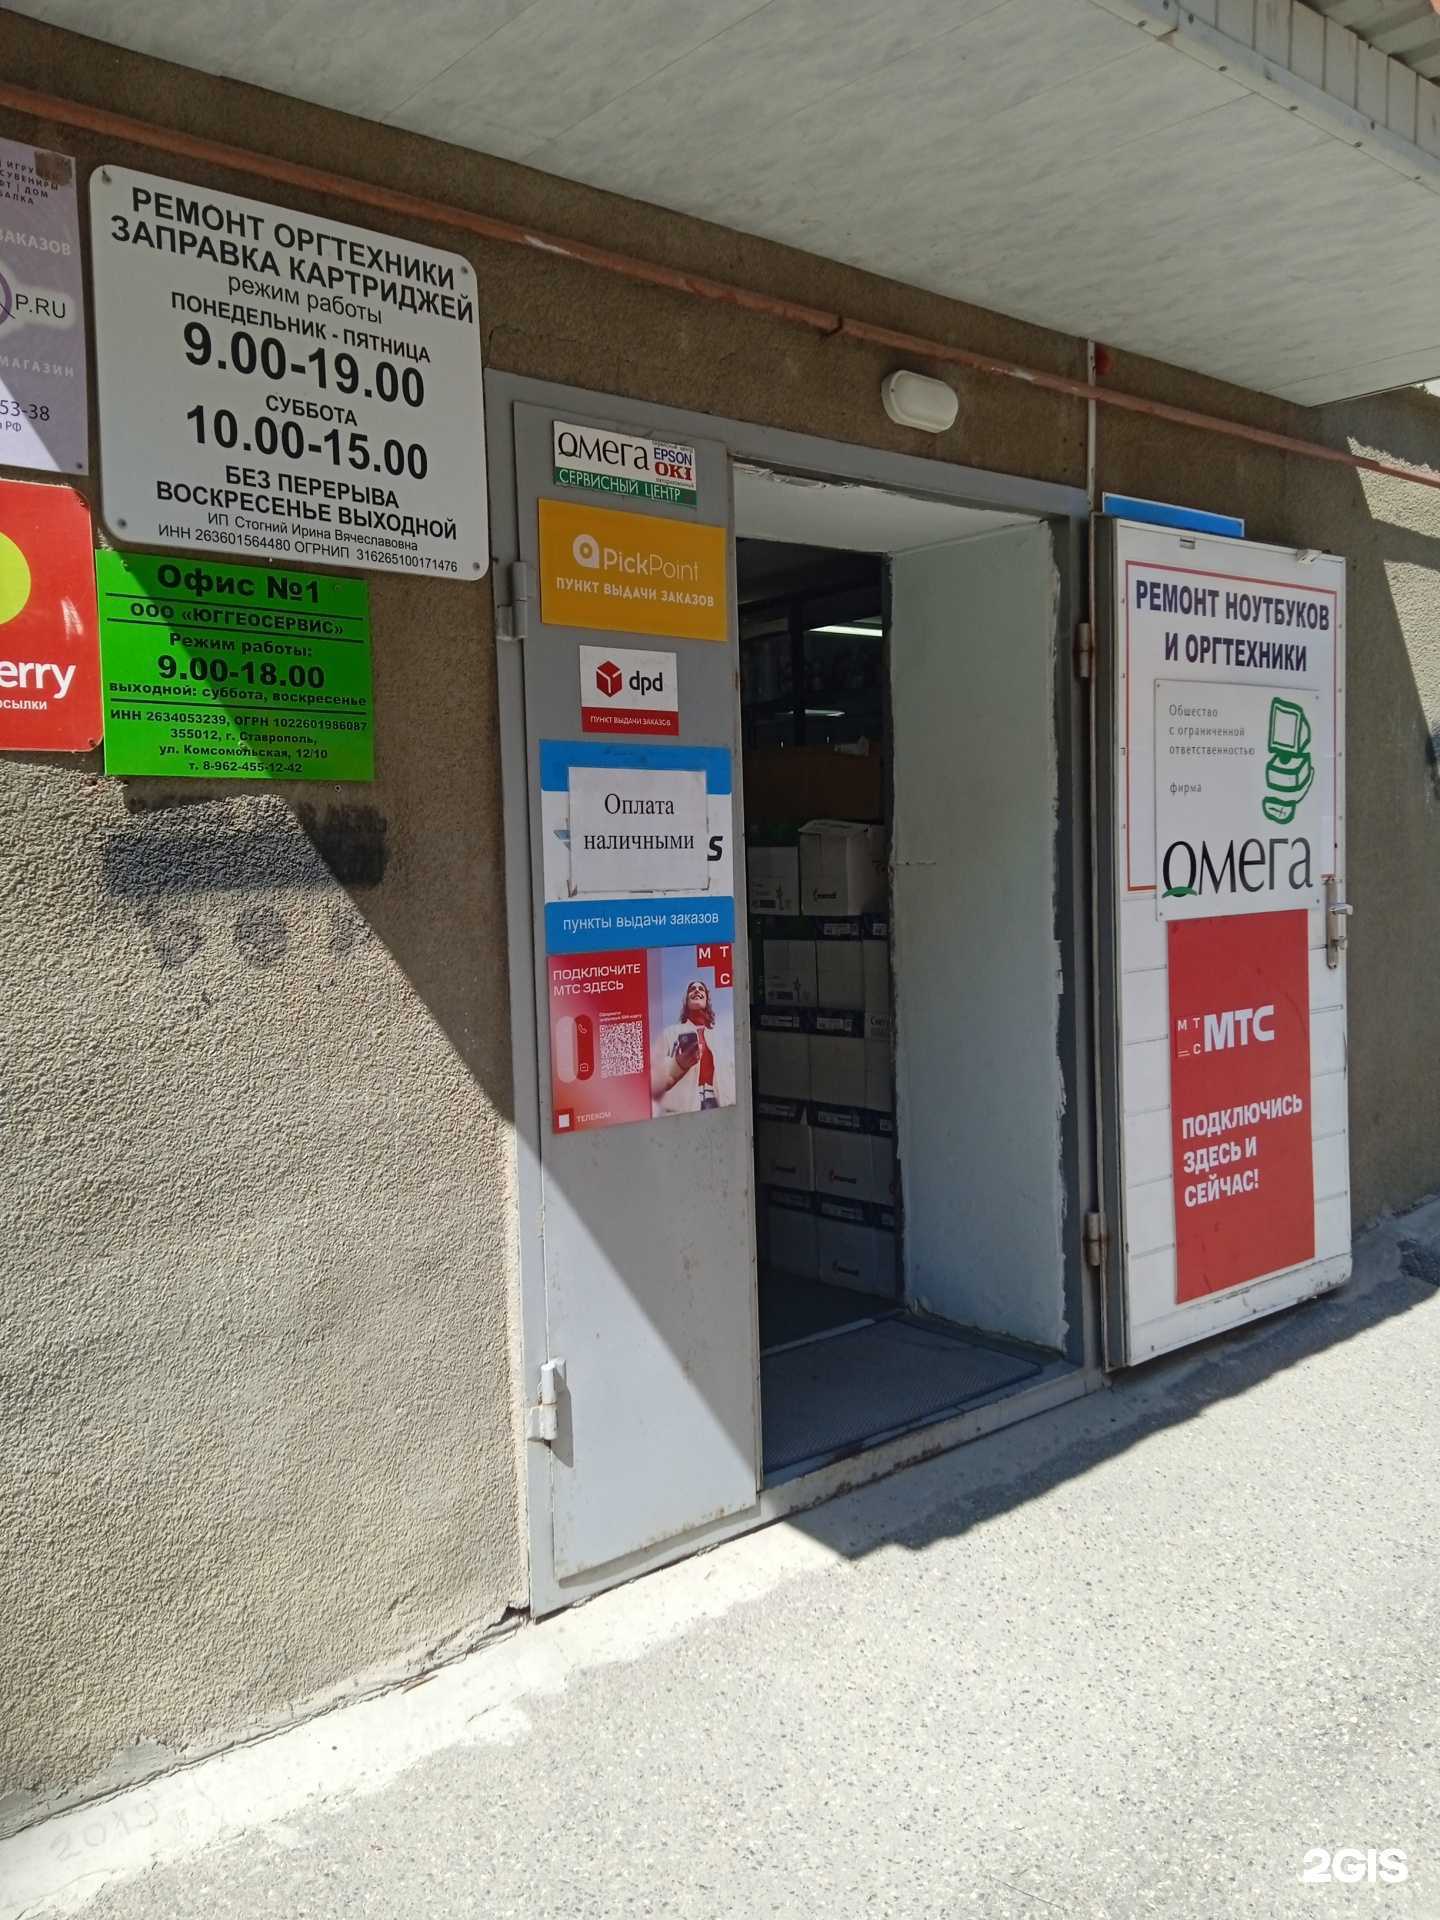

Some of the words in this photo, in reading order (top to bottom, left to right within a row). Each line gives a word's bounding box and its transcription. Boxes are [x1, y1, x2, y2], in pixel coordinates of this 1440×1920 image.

[25, 187, 48, 199] ДОМ
[132, 187, 265, 242] РЕМОНТ
[274, 223, 454, 290] ОРГТЕХНИКИ
[111, 215, 280, 277] ЗАПРАВКА
[289, 256, 474, 324] КАРТРИДЖЕЙ
[228, 274, 300, 306] режим
[307, 292, 382, 325] работы
[171, 291, 327, 341] ПОНЕДЕЛЬНИК
[343, 329, 431, 363] ПЯТНИЦА
[183, 321, 425, 408] 9.00-19.00
[265, 394, 358, 427] СУББОТА
[186, 404, 428, 480] 10.00-15.00
[653, 447, 692, 467] EPSON
[225, 465, 271, 489] БЕЗ
[278, 473, 400, 509] ПЕРЕРЫВА
[559, 467, 640, 496] СЕРВИСНЫЙ
[644, 481, 681, 502] ЦЕНТР
[654, 461, 693, 481] OKI
[156, 480, 332, 523] ВОСКРЕСЕНЬЕ
[338, 506, 457, 541] ВЫХОДНОЙ
[158, 523, 191, 540] ИНН
[195, 528, 291, 552] 263601564480
[294, 540, 349, 559] ОГРНИП
[356, 548, 458, 573] 316265100171476
[208, 512, 229, 526] ИП
[234, 515, 288, 534] Стогний
[292, 523, 331, 540] Ирина
[335, 529, 418, 551] Вячеславовна
[603, 547, 699, 583] PickPoint
[157, 563, 255, 597] Офис
[267, 575, 319, 603] №1
[556, 577, 599, 595] ПУНКТ
[603, 583, 657, 601] ВЫДАЧИ
[660, 590, 715, 608] ЗАКАЗОВ
[130, 602, 175, 620] ООО
[182, 609, 344, 636] «ЮГГЕОСЕРВИС»
[1136, 579, 1220, 619] РЕМОНТ
[1225, 591, 1331, 632] НОУТБУКОВ
[170, 632, 235, 651] Режим
[242, 640, 312, 658] работы:
[1164, 632, 1179, 662] И
[1185, 634, 1308, 673] ОРГТЕХНИКИ
[0, 660, 77, 700] erry
[157, 654, 326, 689] 9.00-18.00
[629, 669, 664, 697] dpd
[109, 682, 197, 697] выходной:
[202, 687, 268, 703] суббота,
[273, 692, 367, 706] воскресенье
[1168, 703, 1219, 718] Общество
[110, 709, 142, 721] ИНН
[146, 711, 231, 727] 2634053239,
[234, 715, 269, 727] ОГРН
[590, 715, 612, 724] ПУНКТ
[1168, 726, 1175, 736] с
[1178, 725, 1246, 739] ограниченной
[160, 745, 180, 756] ул.
[184, 744, 292, 759] Комсомольская,
[296, 748, 328, 759] 12/10
[170, 728, 222, 742] 355012,
[226, 732, 236, 741] г.
[239, 731, 318, 746] Ставрополь,
[1169, 745, 1256, 756] ответственностью
[189, 762, 199, 771] т.
[202, 760, 304, 773] 8-962-455-12-42
[604, 792, 675, 817] Оплата
[1169, 781, 1203, 797] фирма
[582, 830, 695, 852] наличными
[563, 914, 612, 933] пункты
[616, 912, 667, 930] выдачи
[670, 912, 720, 927] заказов
[552, 961, 642, 982] ПОДКЛЮЧИТЕ
[553, 981, 581, 997] МТС
[582, 979, 625, 996] ЗДЕСЬ
[1203, 1004, 1276, 1053] МТС
[1182, 1093, 1304, 1140] ПОДКЛЮЧИСЬ
[1183, 1141, 1242, 1175] ЗДЕСЬ
[1245, 1136, 1258, 1158] И
[1184, 1168, 1260, 1208] СЕЙЧАС!
